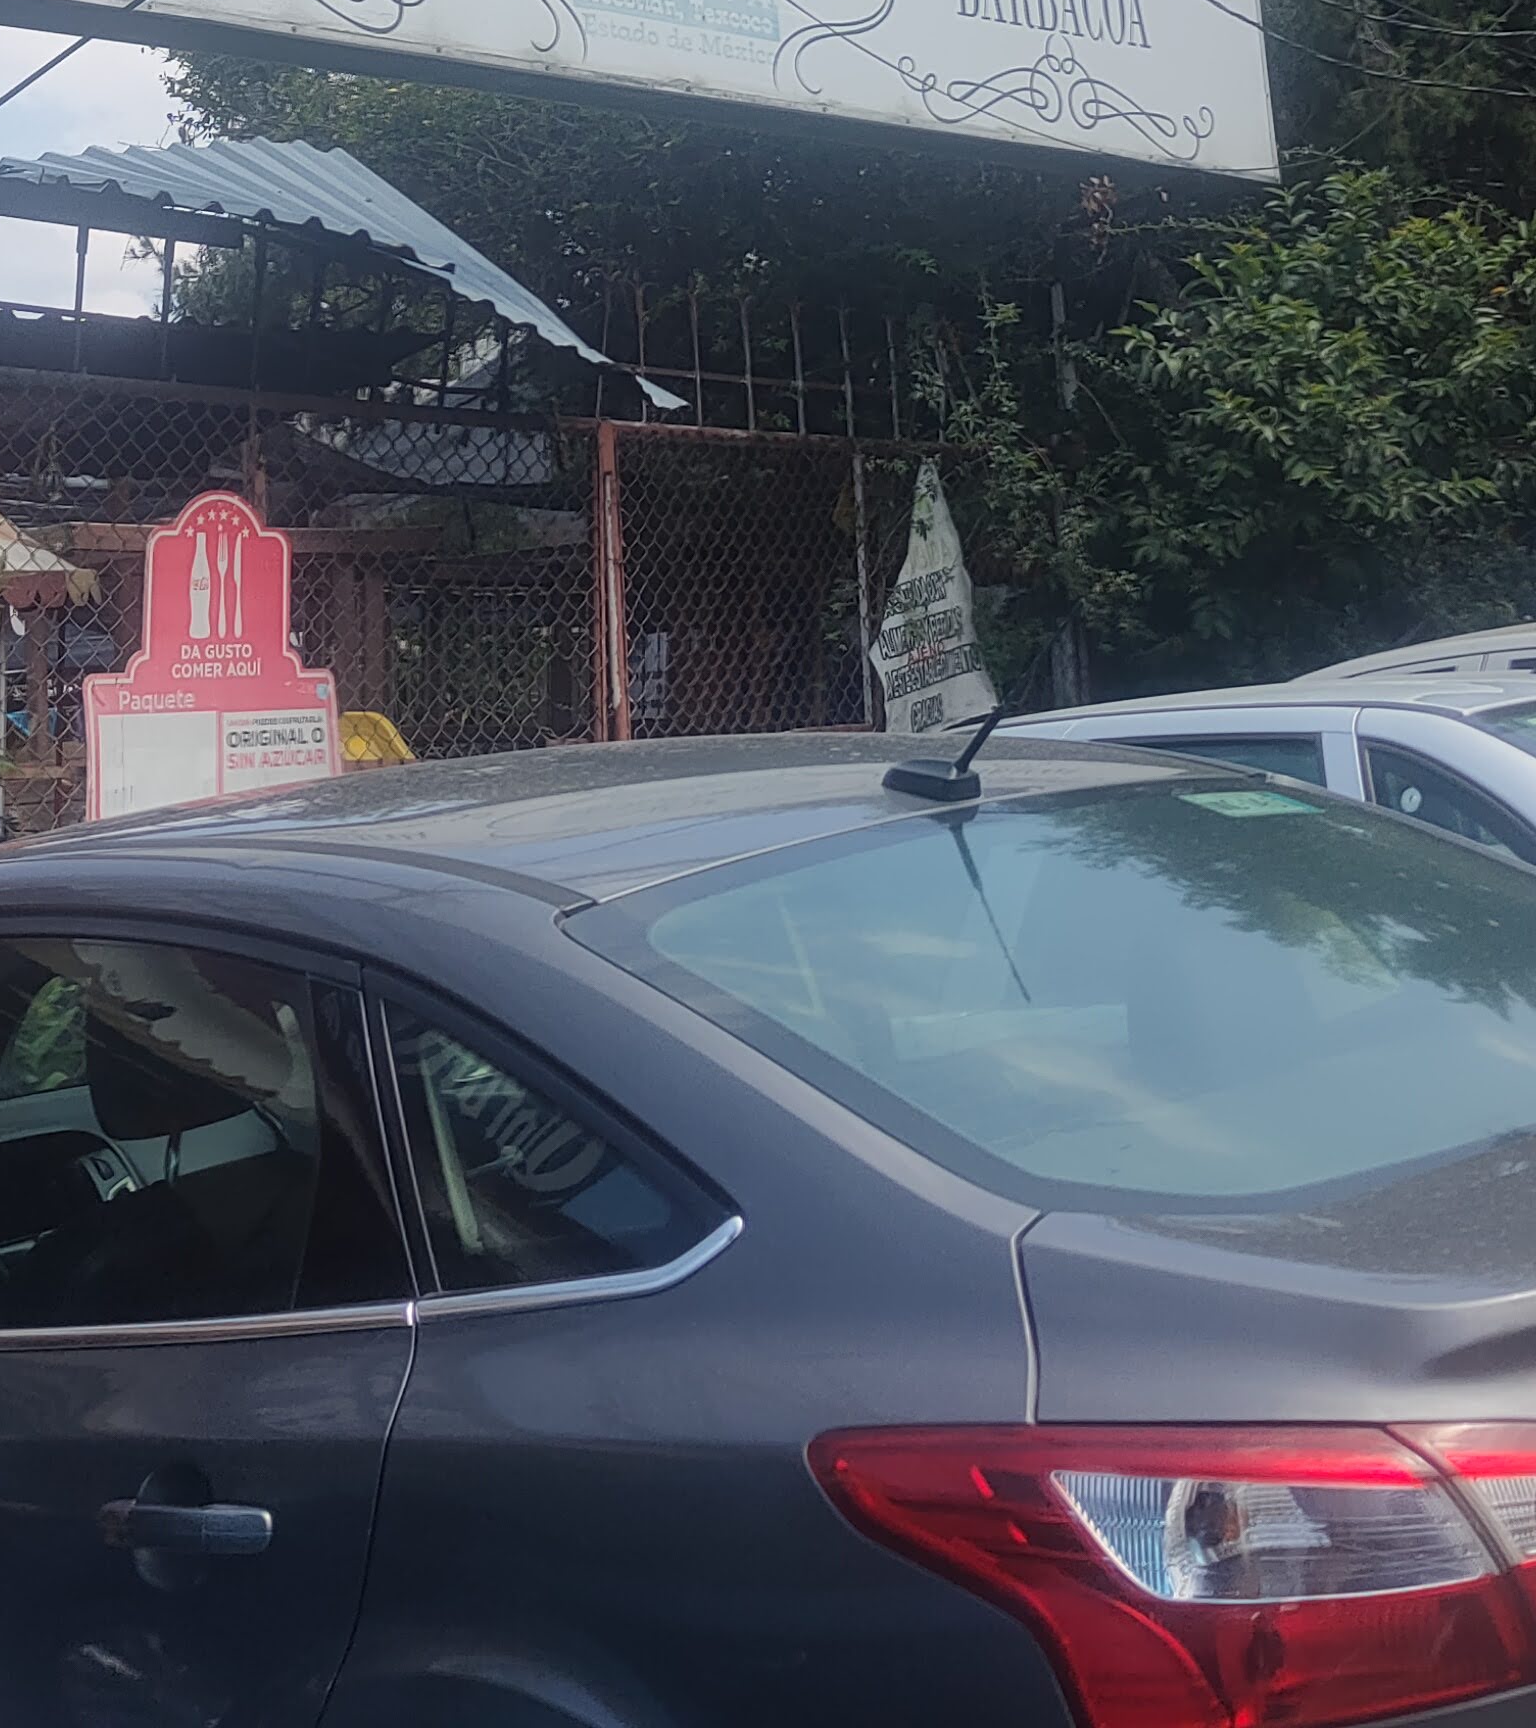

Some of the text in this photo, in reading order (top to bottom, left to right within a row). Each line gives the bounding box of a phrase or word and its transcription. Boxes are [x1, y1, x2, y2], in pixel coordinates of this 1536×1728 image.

[581, 12, 659, 46] Estado
[667, 27, 694, 53] de
[180, 643, 253, 660] DA GUSTO
[171, 657, 262, 679] COMER AQUÍ
[117, 690, 196, 713] Paquete
[225, 727, 325, 749] ORIGINAL O
[225, 752, 256, 770] SIN
